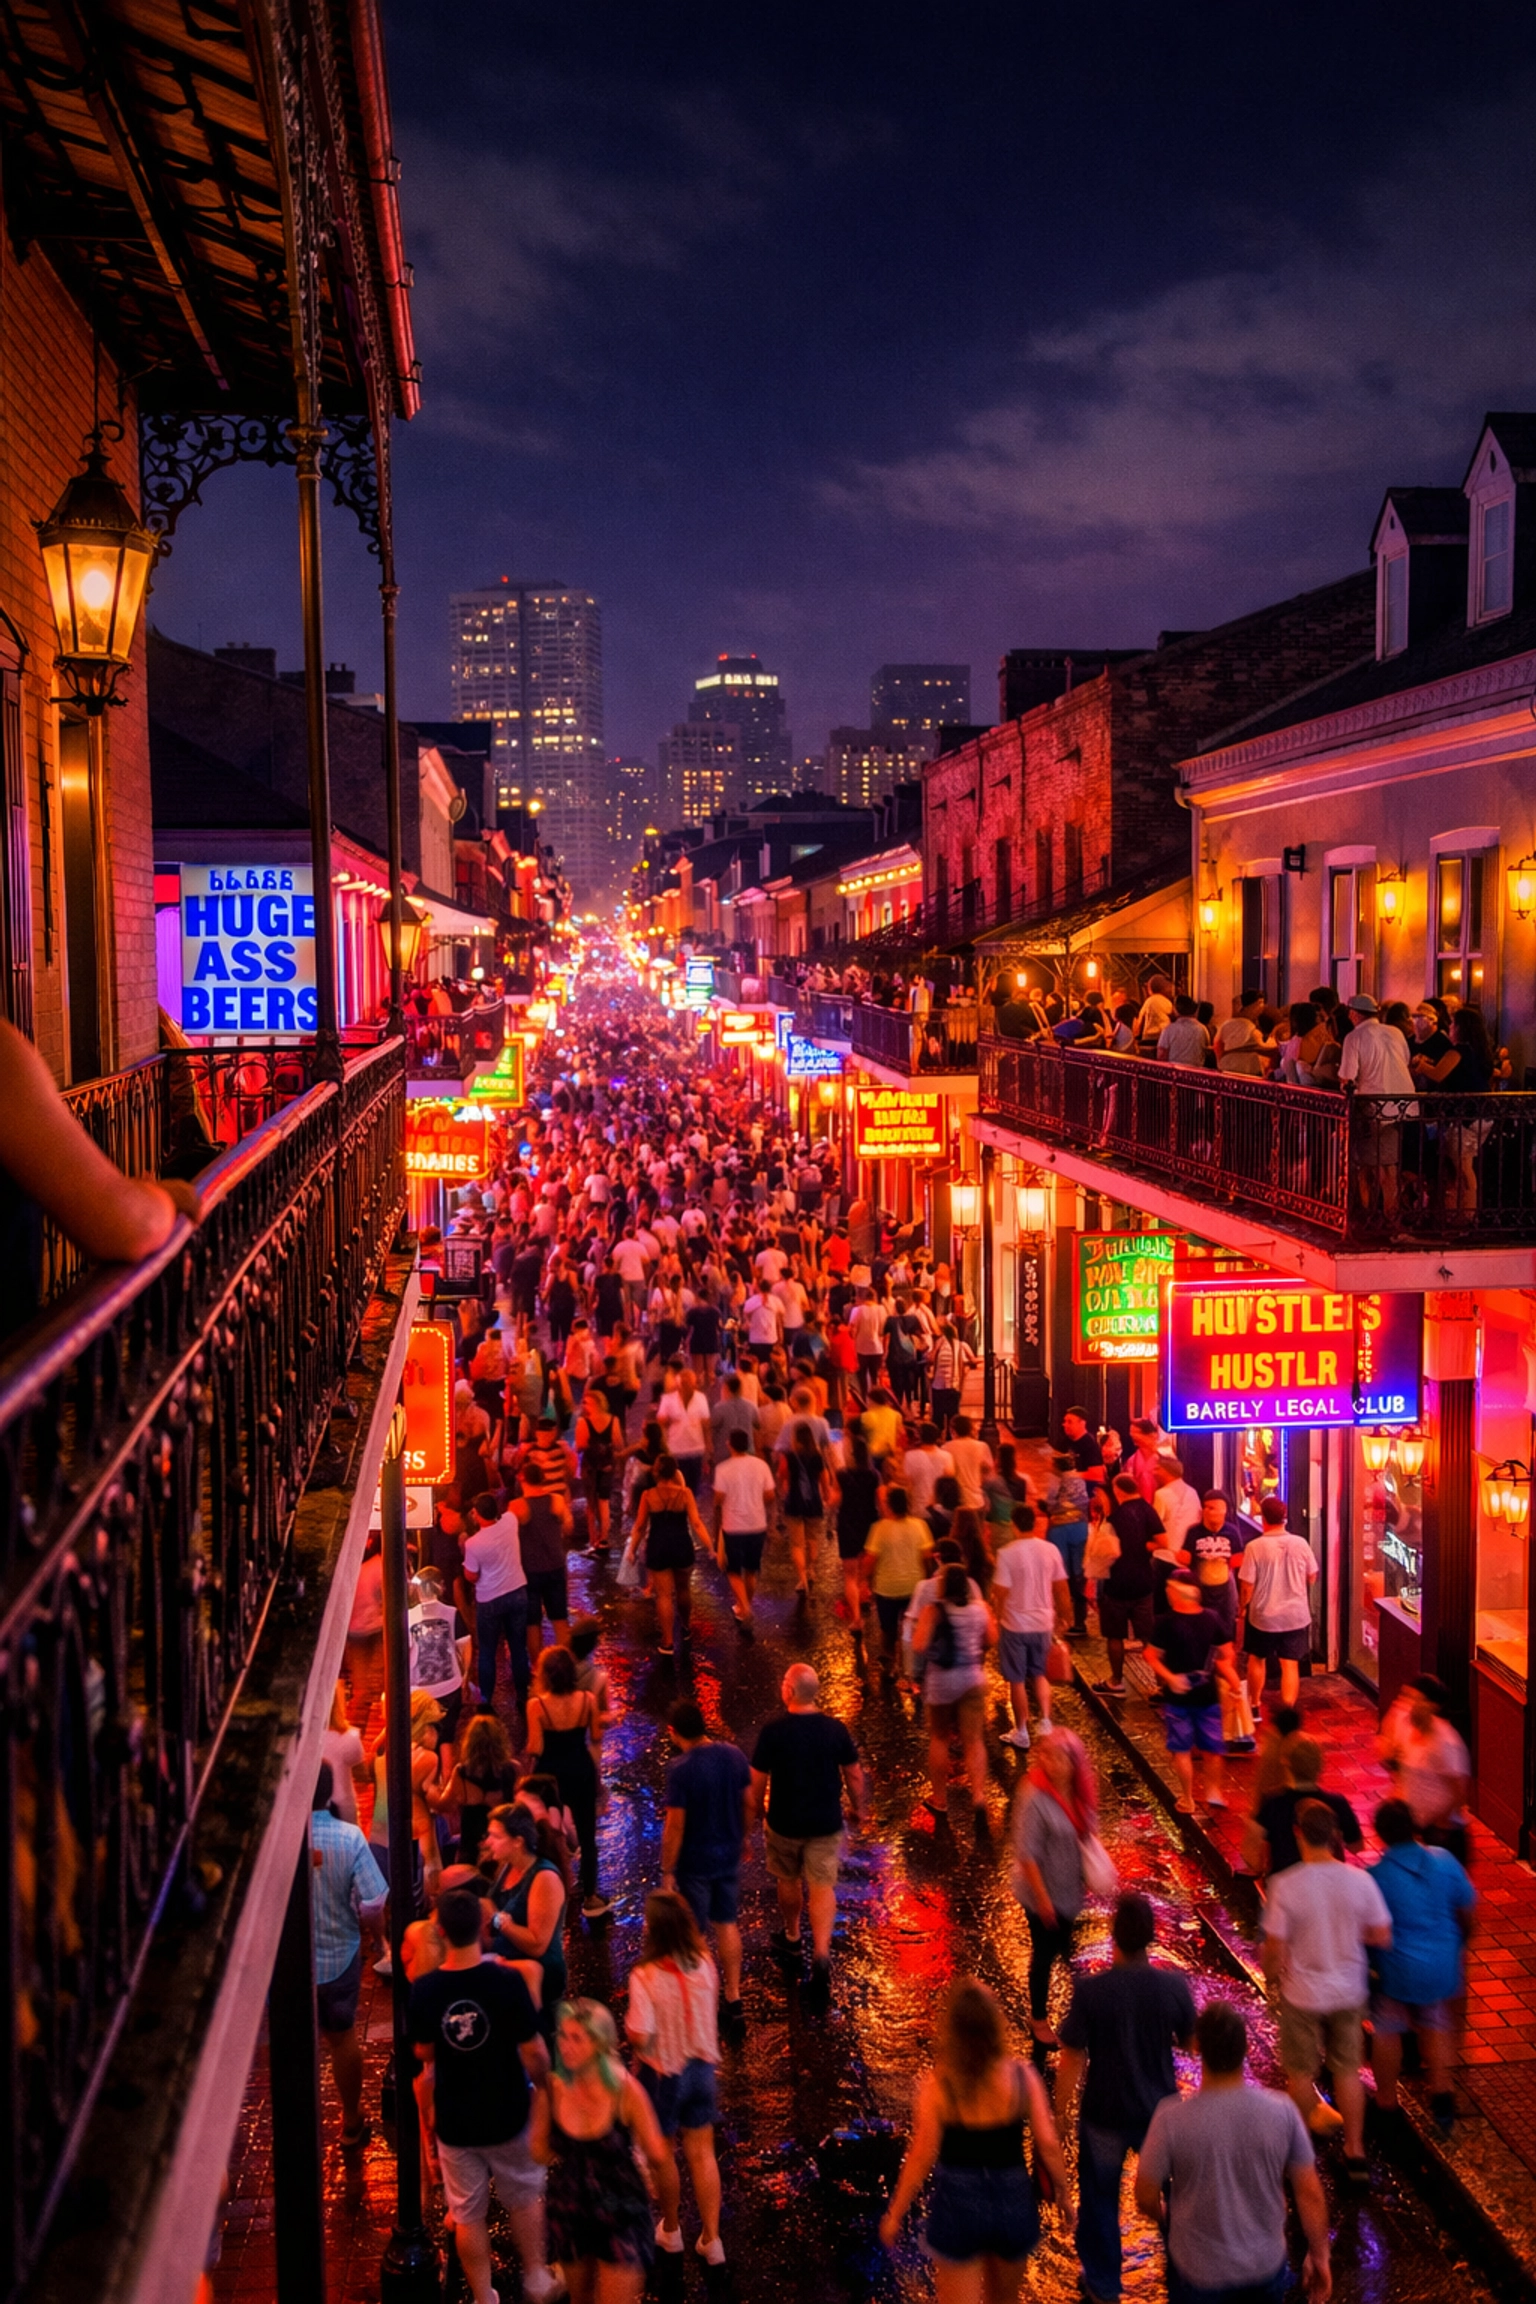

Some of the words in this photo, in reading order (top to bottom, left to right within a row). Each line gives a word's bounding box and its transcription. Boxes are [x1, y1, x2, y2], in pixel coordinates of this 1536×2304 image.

[185, 895, 316, 938] HUGE
[193, 940, 297, 982] ASS
[182, 986, 318, 1032] BEERS
[1210, 1351, 1338, 1390] HUSTLR
[1186, 1401, 1264, 1420] BARELY
[1275, 1398, 1341, 1417] LEGAL
[1352, 1395, 1406, 1415] CLUB
